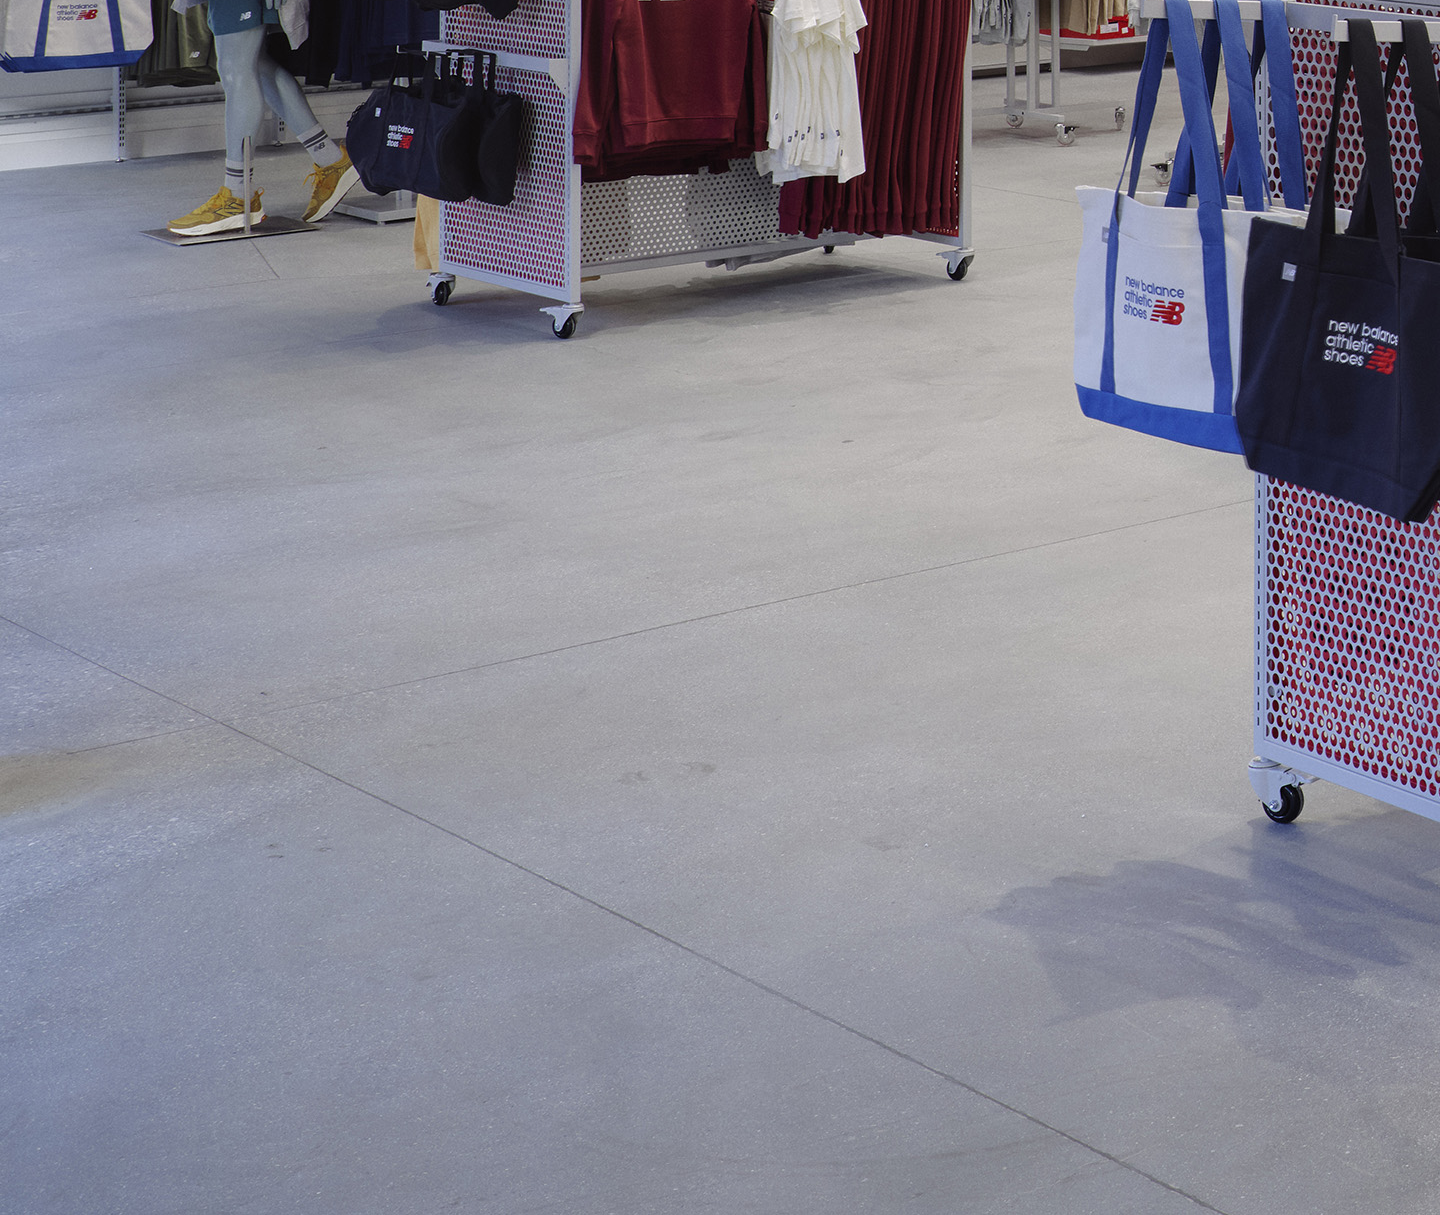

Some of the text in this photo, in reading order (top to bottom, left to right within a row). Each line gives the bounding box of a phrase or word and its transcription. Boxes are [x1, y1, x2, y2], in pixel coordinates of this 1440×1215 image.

[76, 10, 98, 21] NB
[240, 11, 251, 21] NB
[1126, 276, 1184, 298] new balance
[1124, 290, 1152, 308] athletic
[1123, 303, 1147, 320] shoes
[1150, 300, 1185, 326] NB
[1328, 320, 1398, 346] new balance
[1326, 334, 1375, 354] athletic
[1324, 348, 1364, 366] shoes
[1365, 345, 1397, 375] NB
